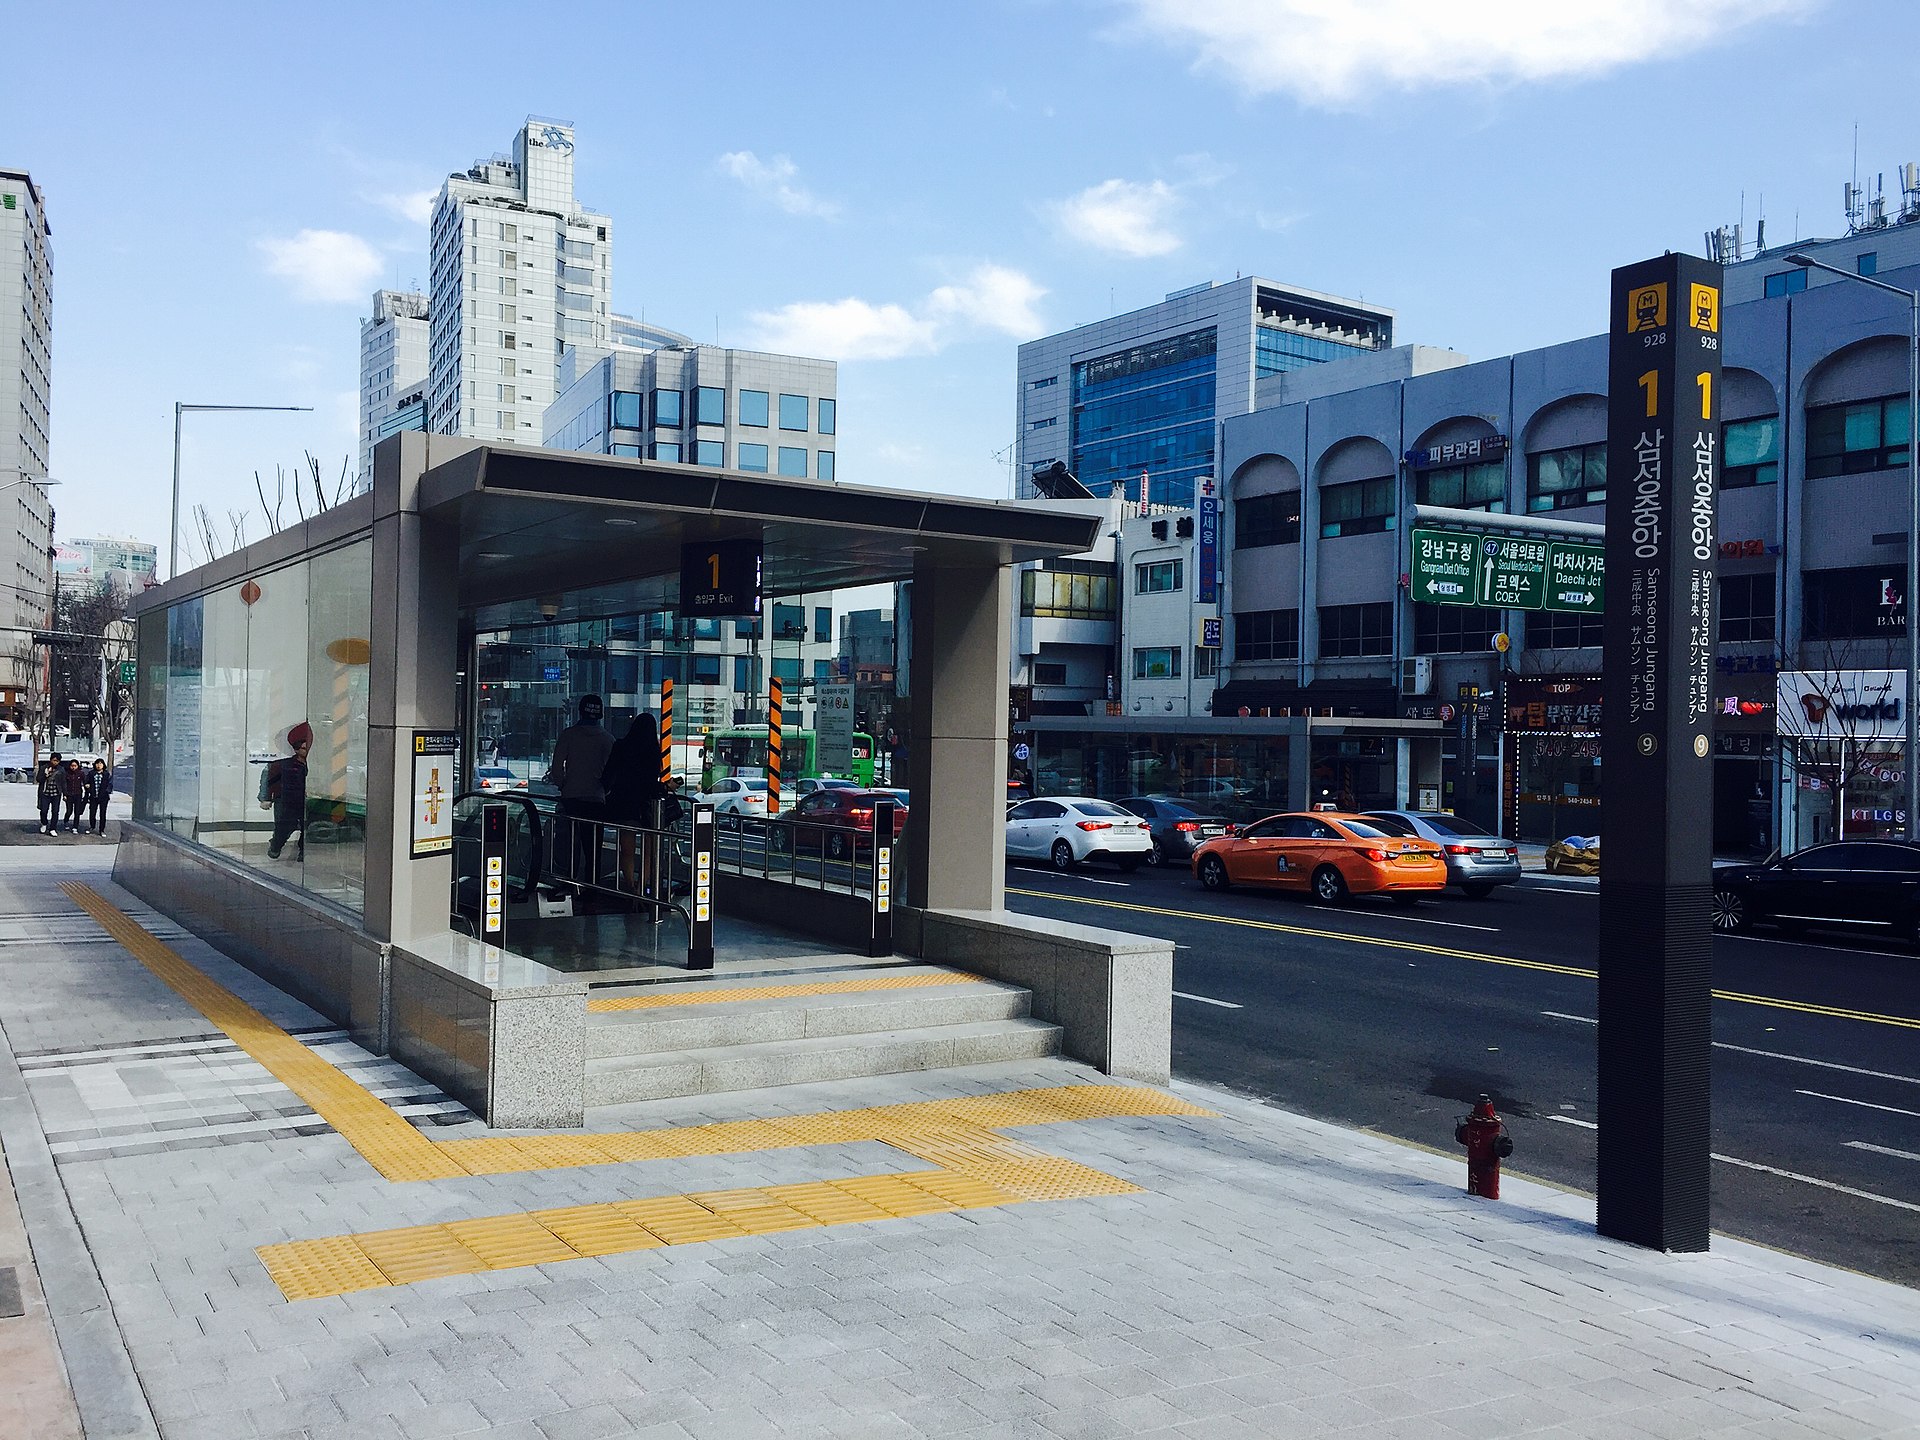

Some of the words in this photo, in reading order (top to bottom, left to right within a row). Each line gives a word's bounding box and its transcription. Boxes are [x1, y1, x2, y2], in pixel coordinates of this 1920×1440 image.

[528, 138, 544, 148] the
[1644, 332, 1667, 348] 928
[1701, 335, 1718, 350] 928
[1638, 369, 1659, 418] 1
[1696, 371, 1712, 420] 1
[1429, 439, 1481, 463] 피부관리
[1631, 428, 1665, 559] 삼성중앙
[1691, 431, 1716, 561] 삼성중앙
[1421, 539, 1472, 562] 강남구청
[1485, 543, 1497, 553] 47
[1499, 541, 1546, 562] 서울의료원
[1718, 539, 1764, 559] 의원
[706, 553, 720, 589] 1
[1420, 560, 1443, 576] Gangnam
[1443, 562, 1454, 575] Dist
[1454, 563, 1470, 576] Office
[1497, 559, 1511, 570] Seoul
[1511, 560, 1529, 572] Medical
[1529, 561, 1544, 573] Center
[1553, 552, 1605, 574] 대치사거리
[1496, 574, 1531, 591] 코엑스
[1555, 572, 1586, 586] Daechi
[1587, 574, 1602, 587] Jct
[719, 593, 734, 604] Exit
[1495, 590, 1521, 603] COEX
[1631, 569, 1643, 616] 三成中央
[1690, 568, 1700, 617] 三成中央
[1643, 567, 1660, 645] Samseong
[1699, 570, 1713, 647] Samseong
[1877, 615, 1906, 626] BAR
[1552, 683, 1571, 693] TOP
[1642, 649, 1659, 711] Jungang
[1697, 650, 1711, 713] Jungang
[1461, 703, 1468, 713] 7
[1472, 703, 1478, 713] 7
[1835, 697, 1900, 721] world
[1367, 738, 1375, 749] 7
[1535, 739, 1602, 758] 540-245
[1642, 737, 1653, 752] 9
[1697, 737, 1705, 752] 9
[1851, 808, 1869, 821] KT
[1874, 809, 1893, 821] LG
